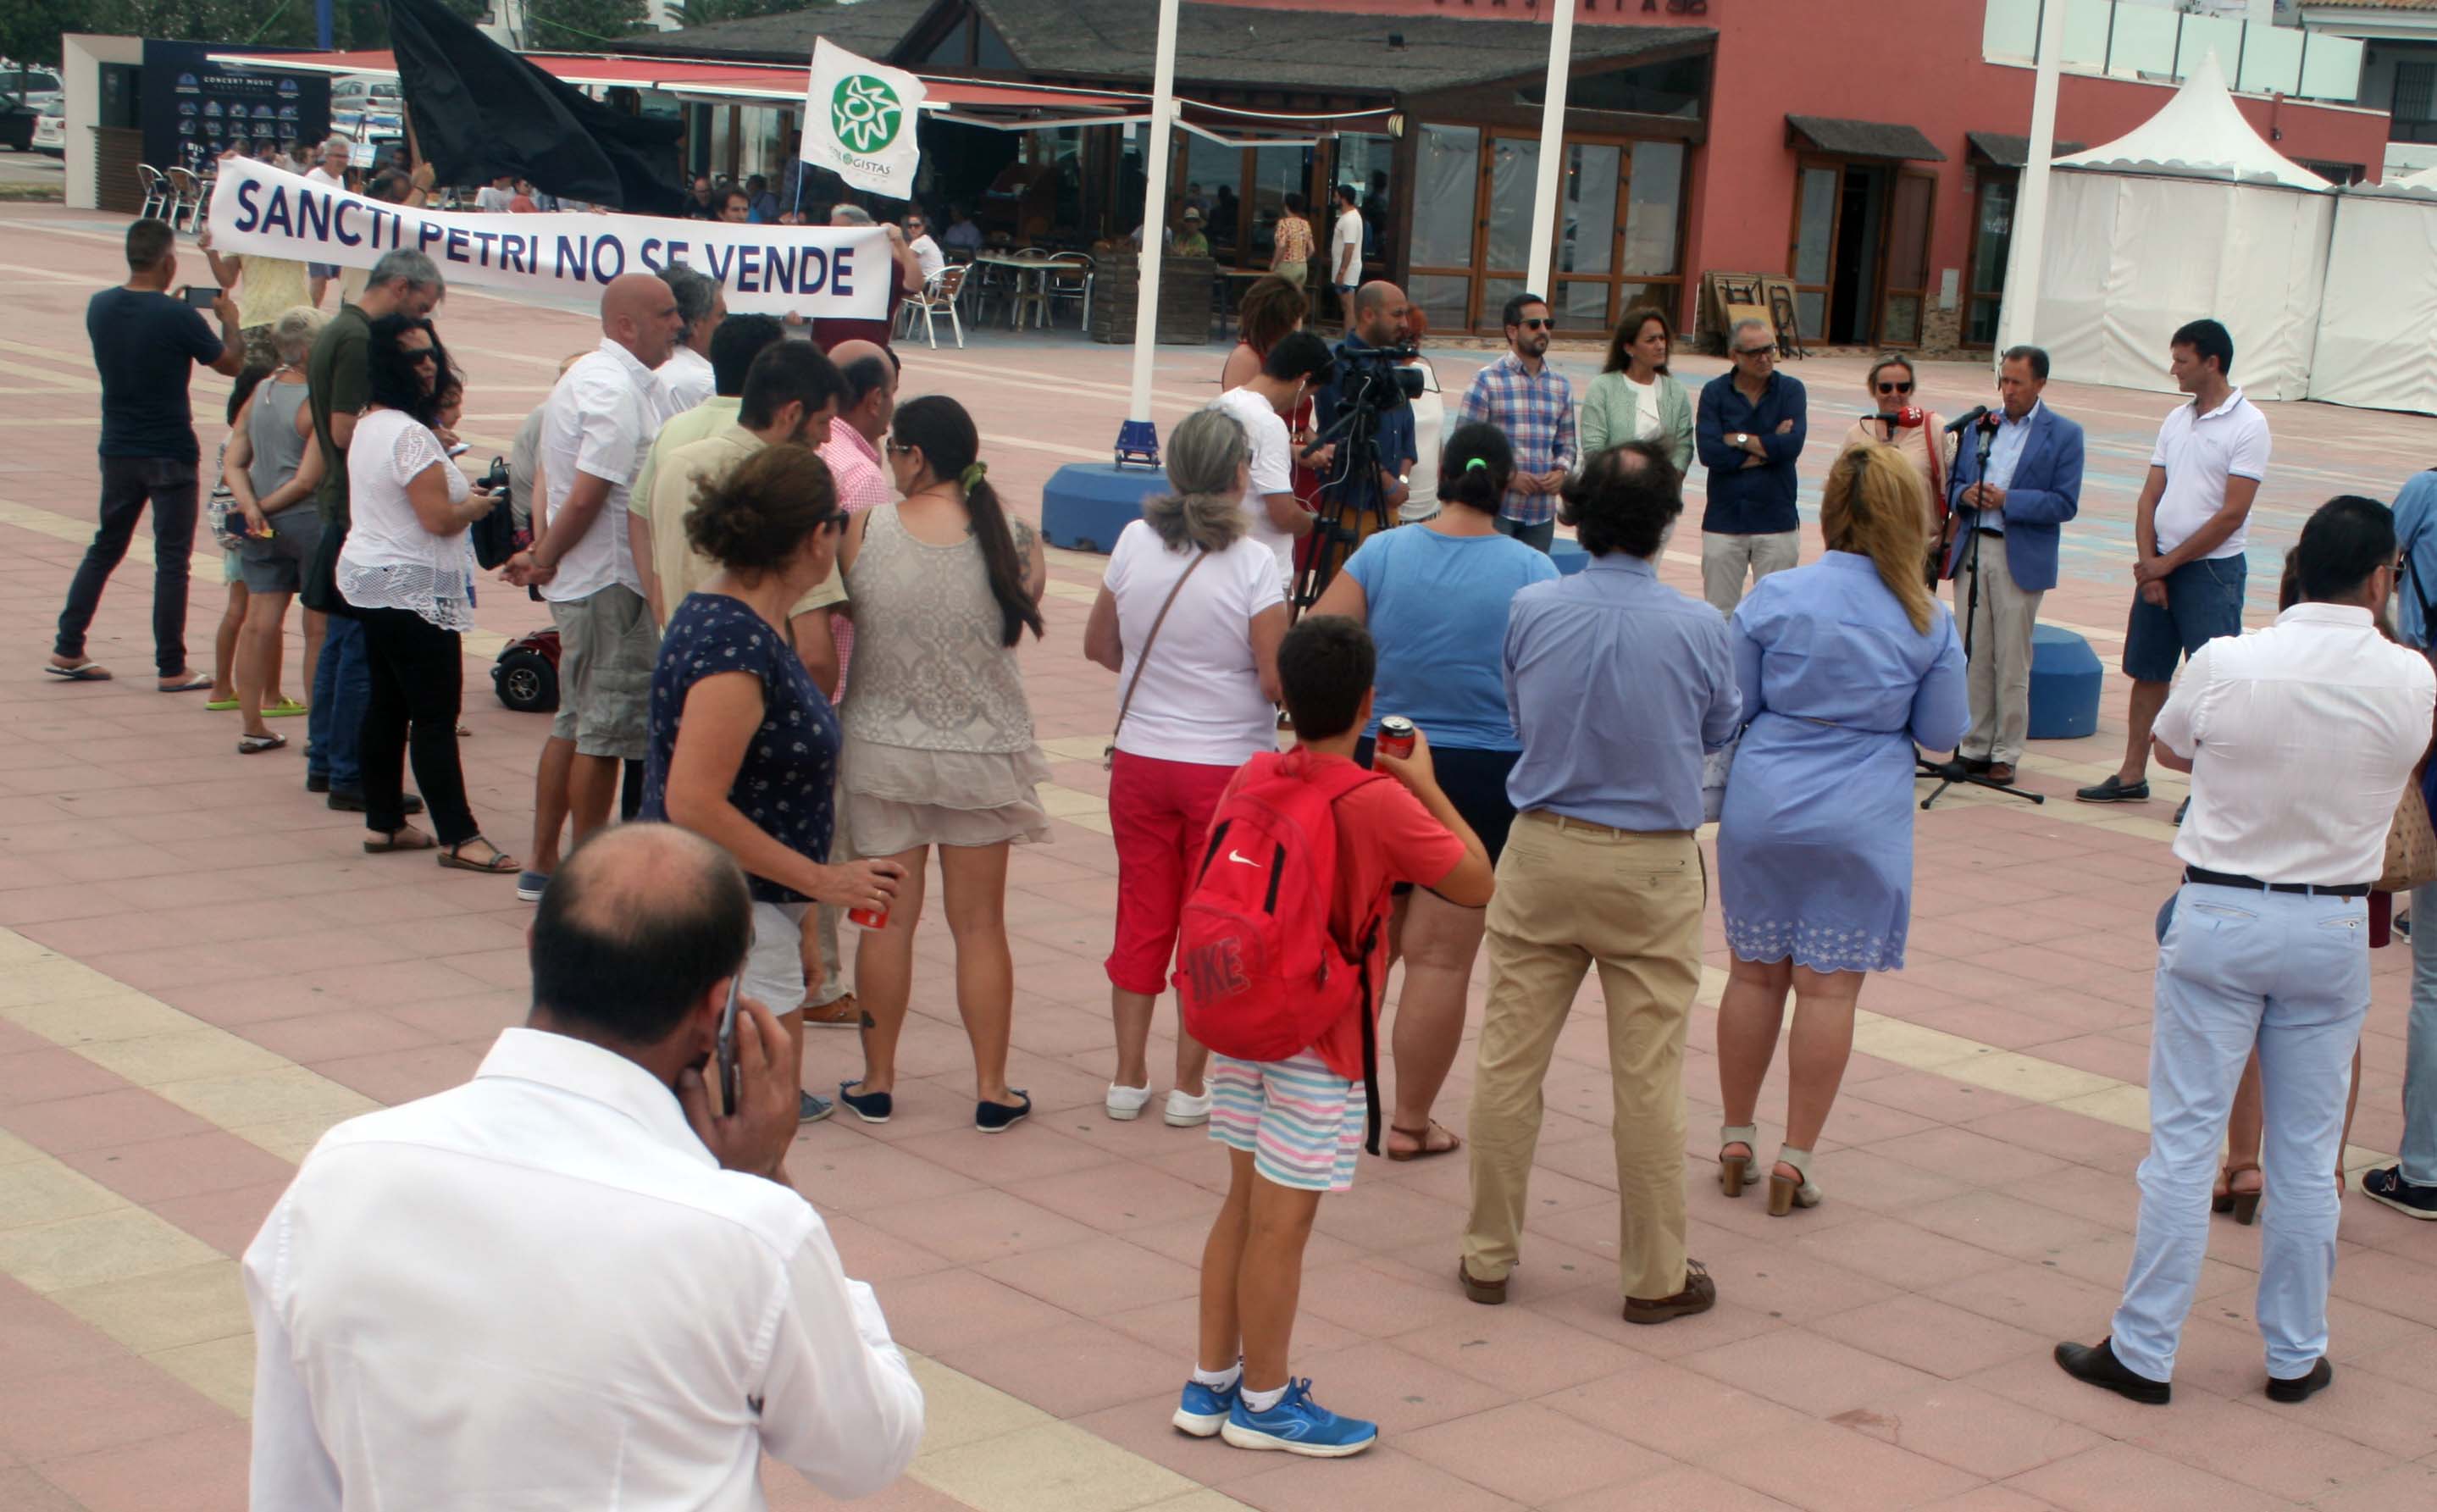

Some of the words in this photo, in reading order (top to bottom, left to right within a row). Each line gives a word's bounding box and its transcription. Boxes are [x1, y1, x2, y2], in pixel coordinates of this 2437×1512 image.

[235, 180, 402, 249] SANCTI
[418, 221, 538, 274] PETRI
[556, 234, 625, 285] NO
[706, 244, 854, 296] VENDE
[1188, 935, 1251, 1006] IKE
